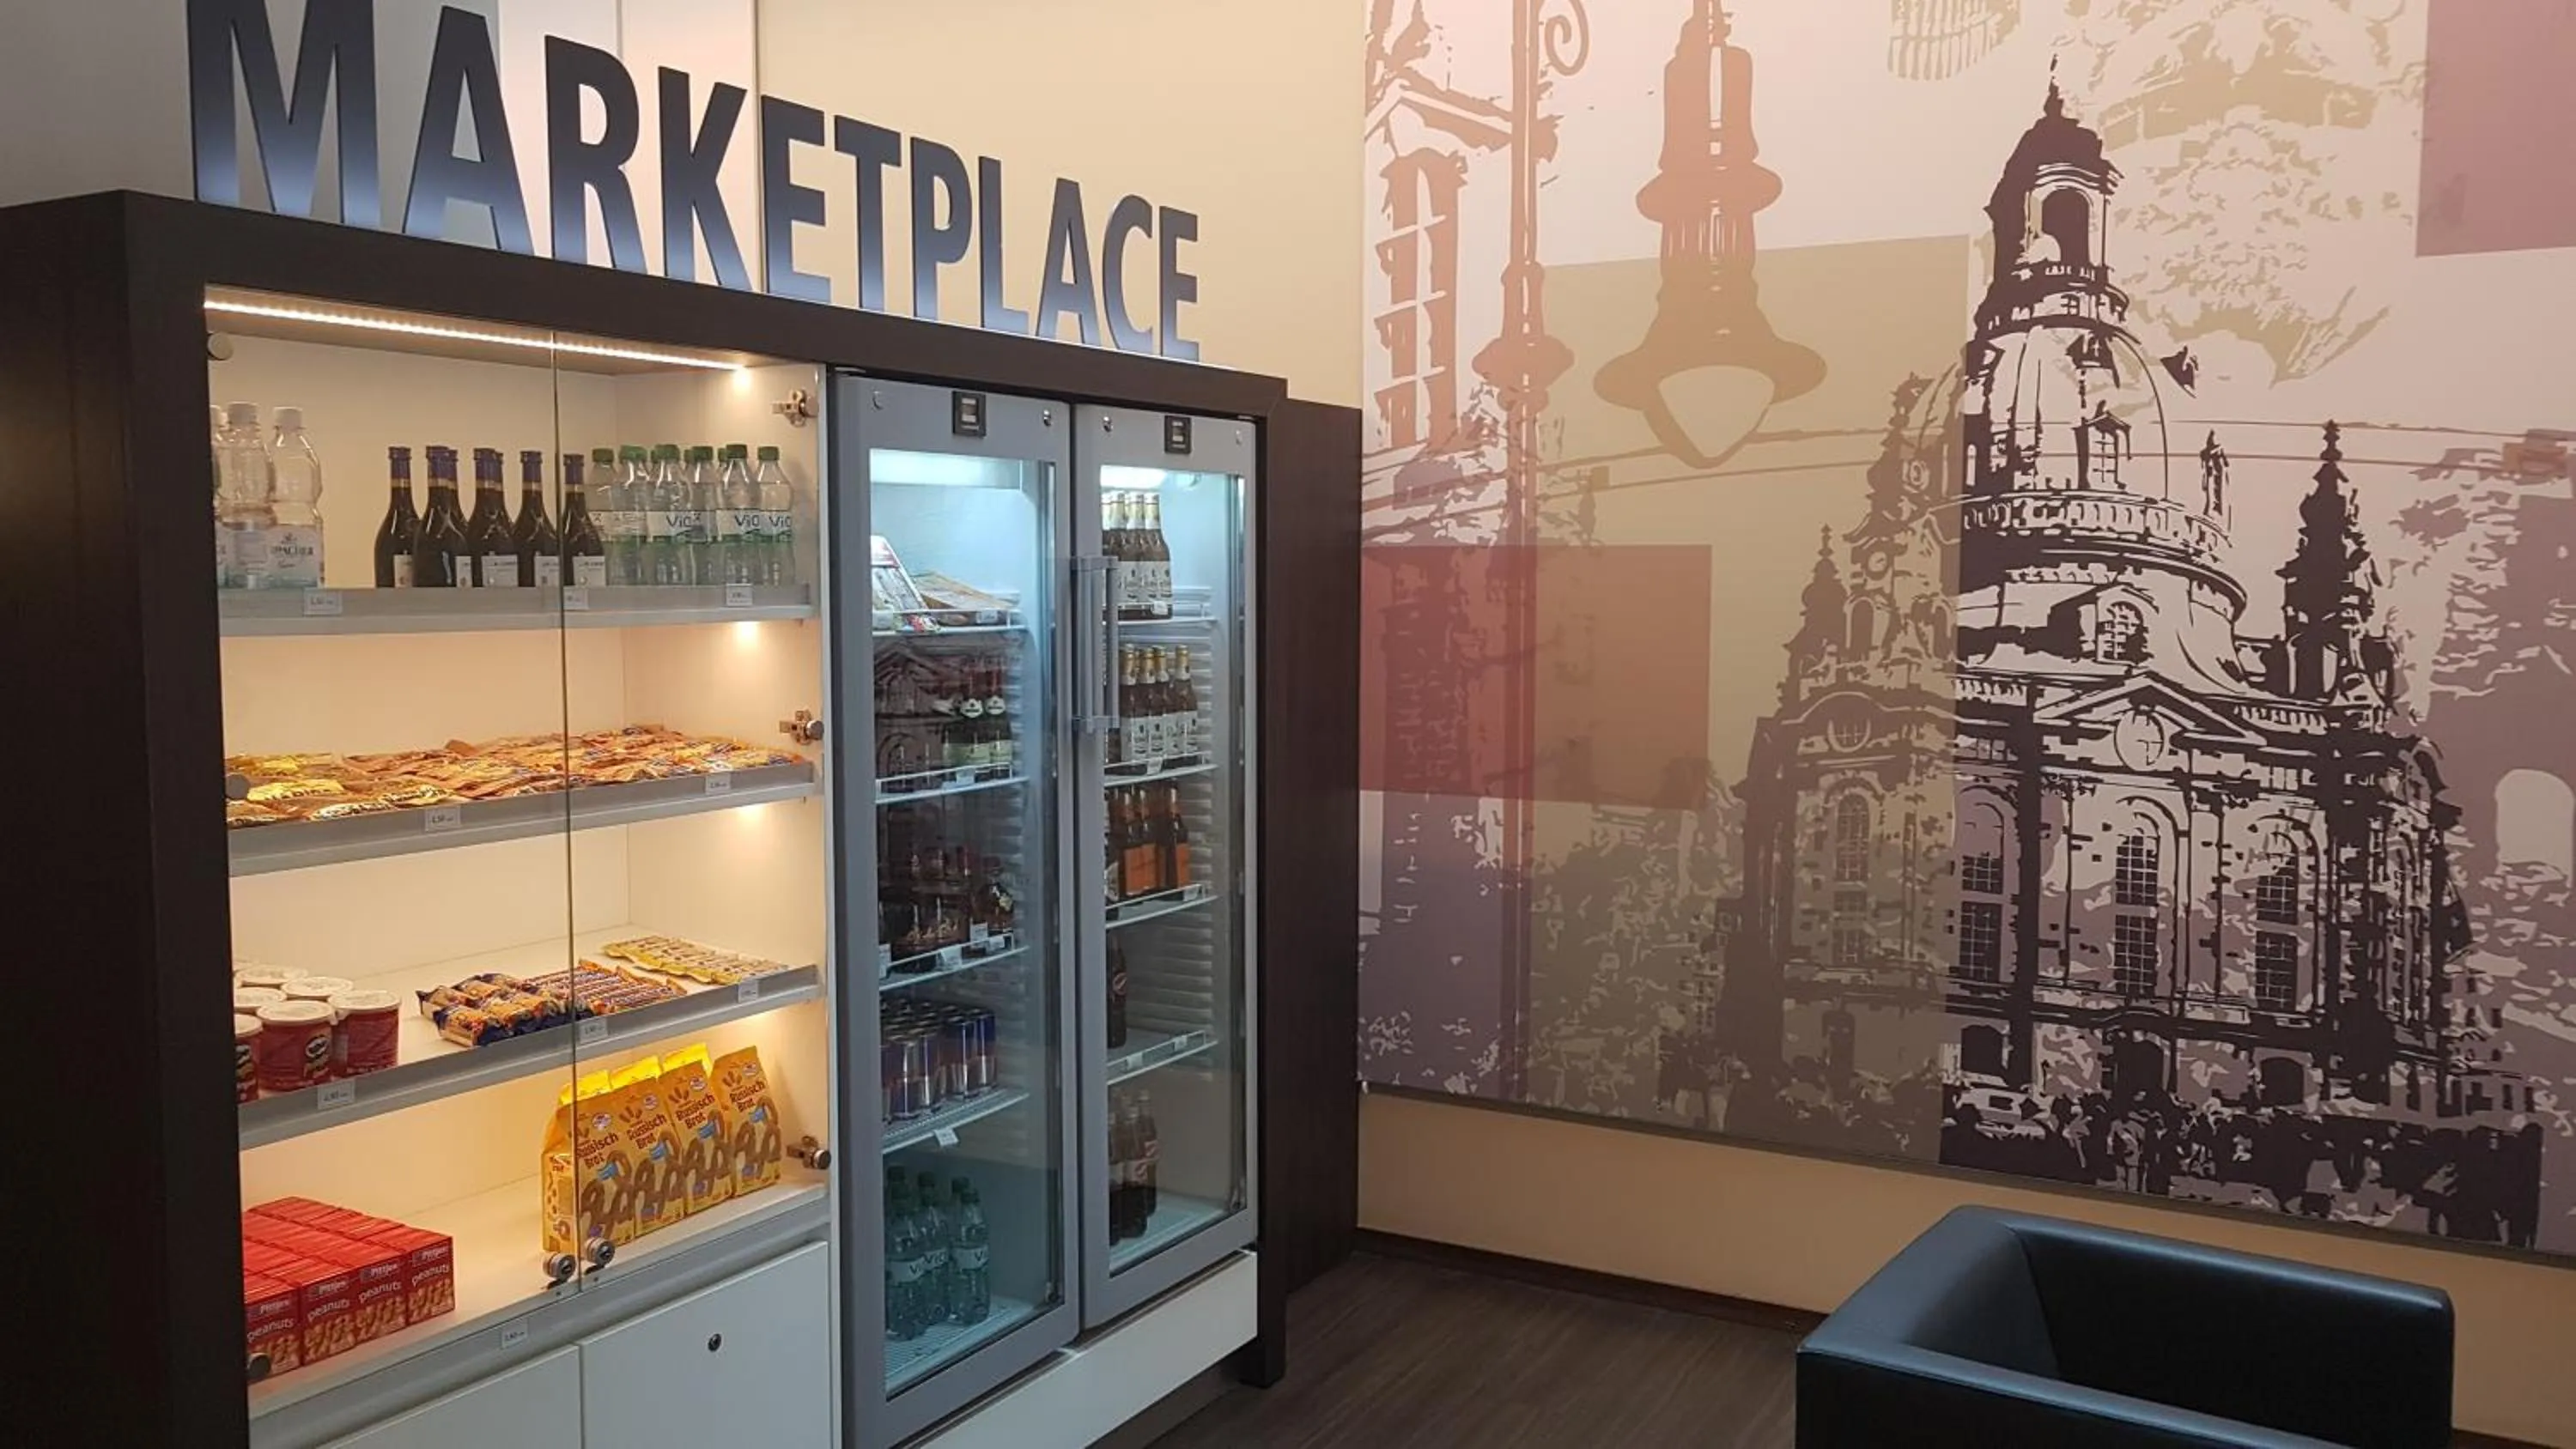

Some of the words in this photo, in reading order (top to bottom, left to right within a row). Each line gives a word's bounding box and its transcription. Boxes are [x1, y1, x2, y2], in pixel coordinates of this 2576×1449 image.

[187, 0, 1200, 361] MARKETPLACE
[675, 1093, 715, 1122] Russisch
[626, 1113, 667, 1141] Russisch
[685, 1113, 706, 1129] Brot
[411, 1264, 450, 1288] peanuts
[358, 1281, 402, 1304] peanuts
[307, 1298, 350, 1322] peanuts
